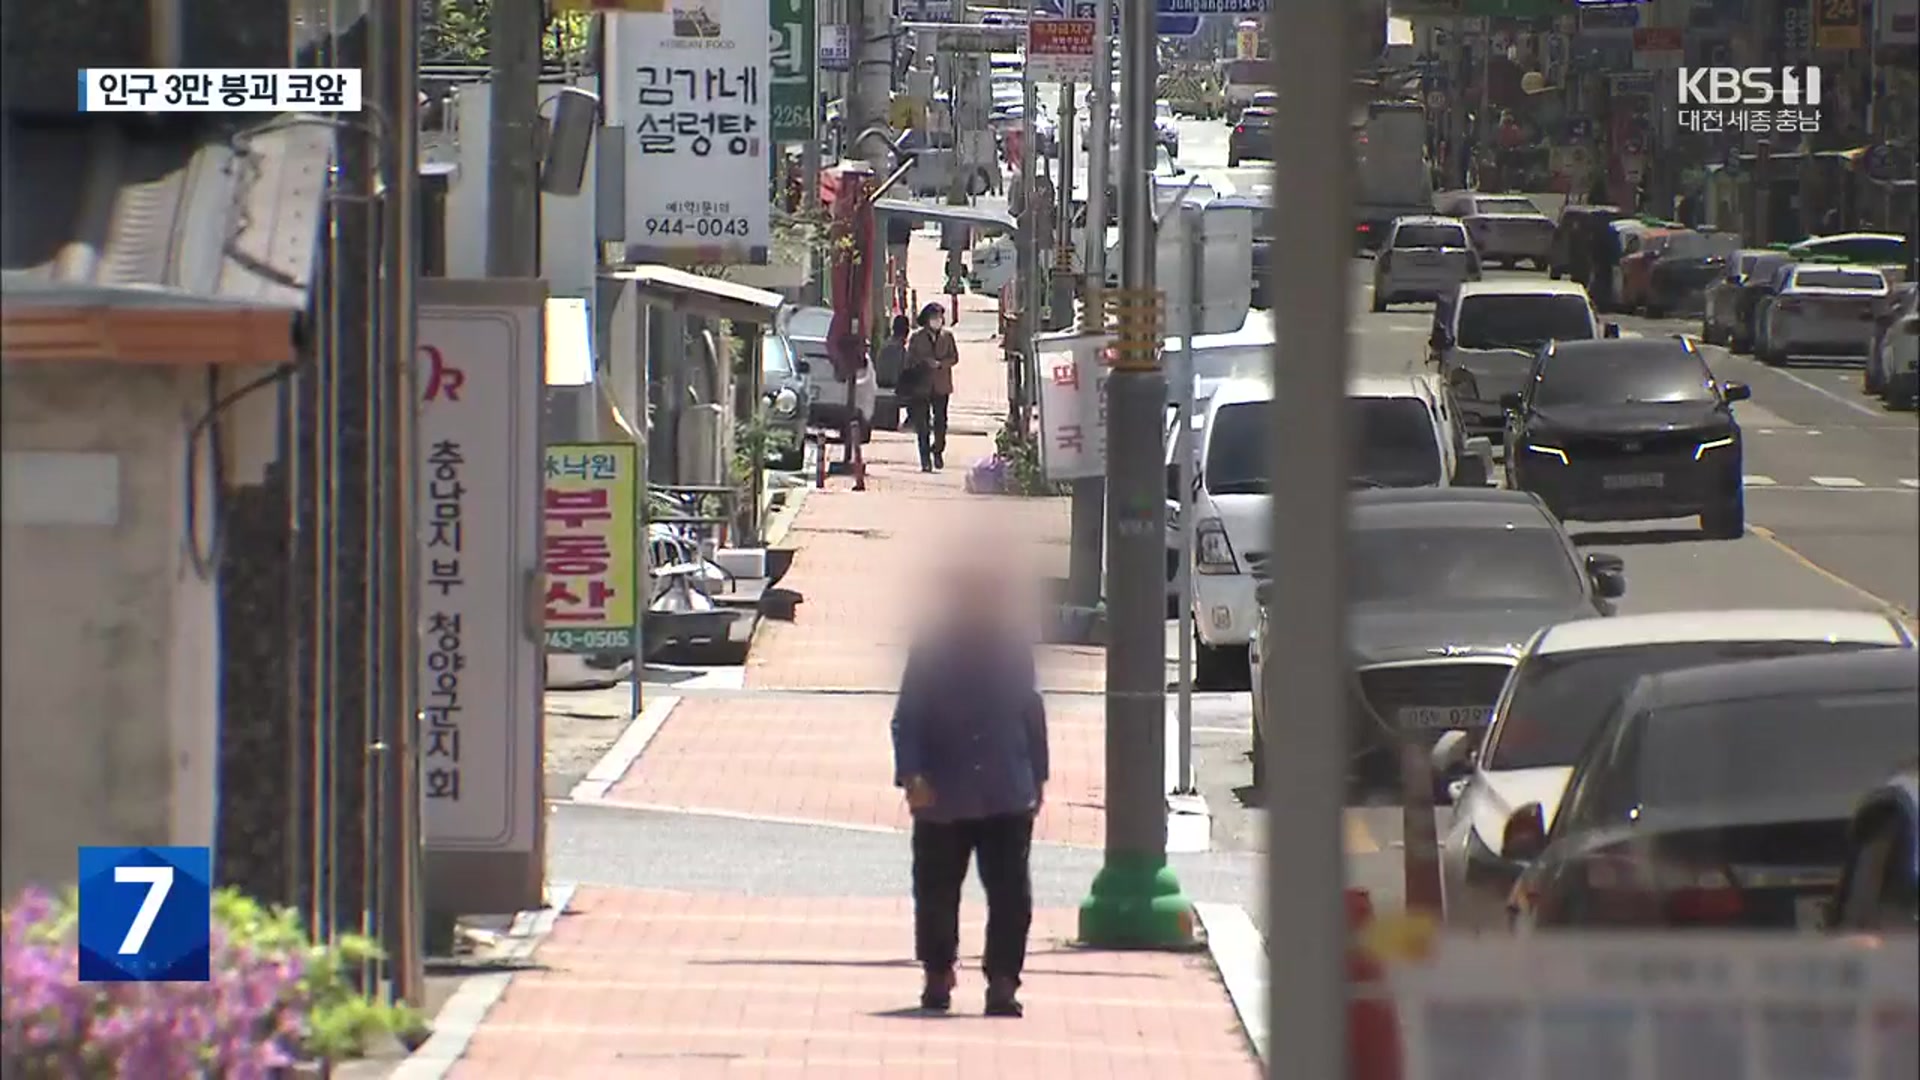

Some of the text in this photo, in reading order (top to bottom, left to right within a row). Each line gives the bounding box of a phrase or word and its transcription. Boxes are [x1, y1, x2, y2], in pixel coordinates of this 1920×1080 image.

[636, 65, 757, 105] 김가네
[636, 112, 758, 157] 설렁탕
[645, 218, 749, 236] 944-0043
[545, 488, 615, 621] 부동산
[425, 440, 467, 801] 충남지부 청양군지회
[545, 630, 629, 648] 43-0505
